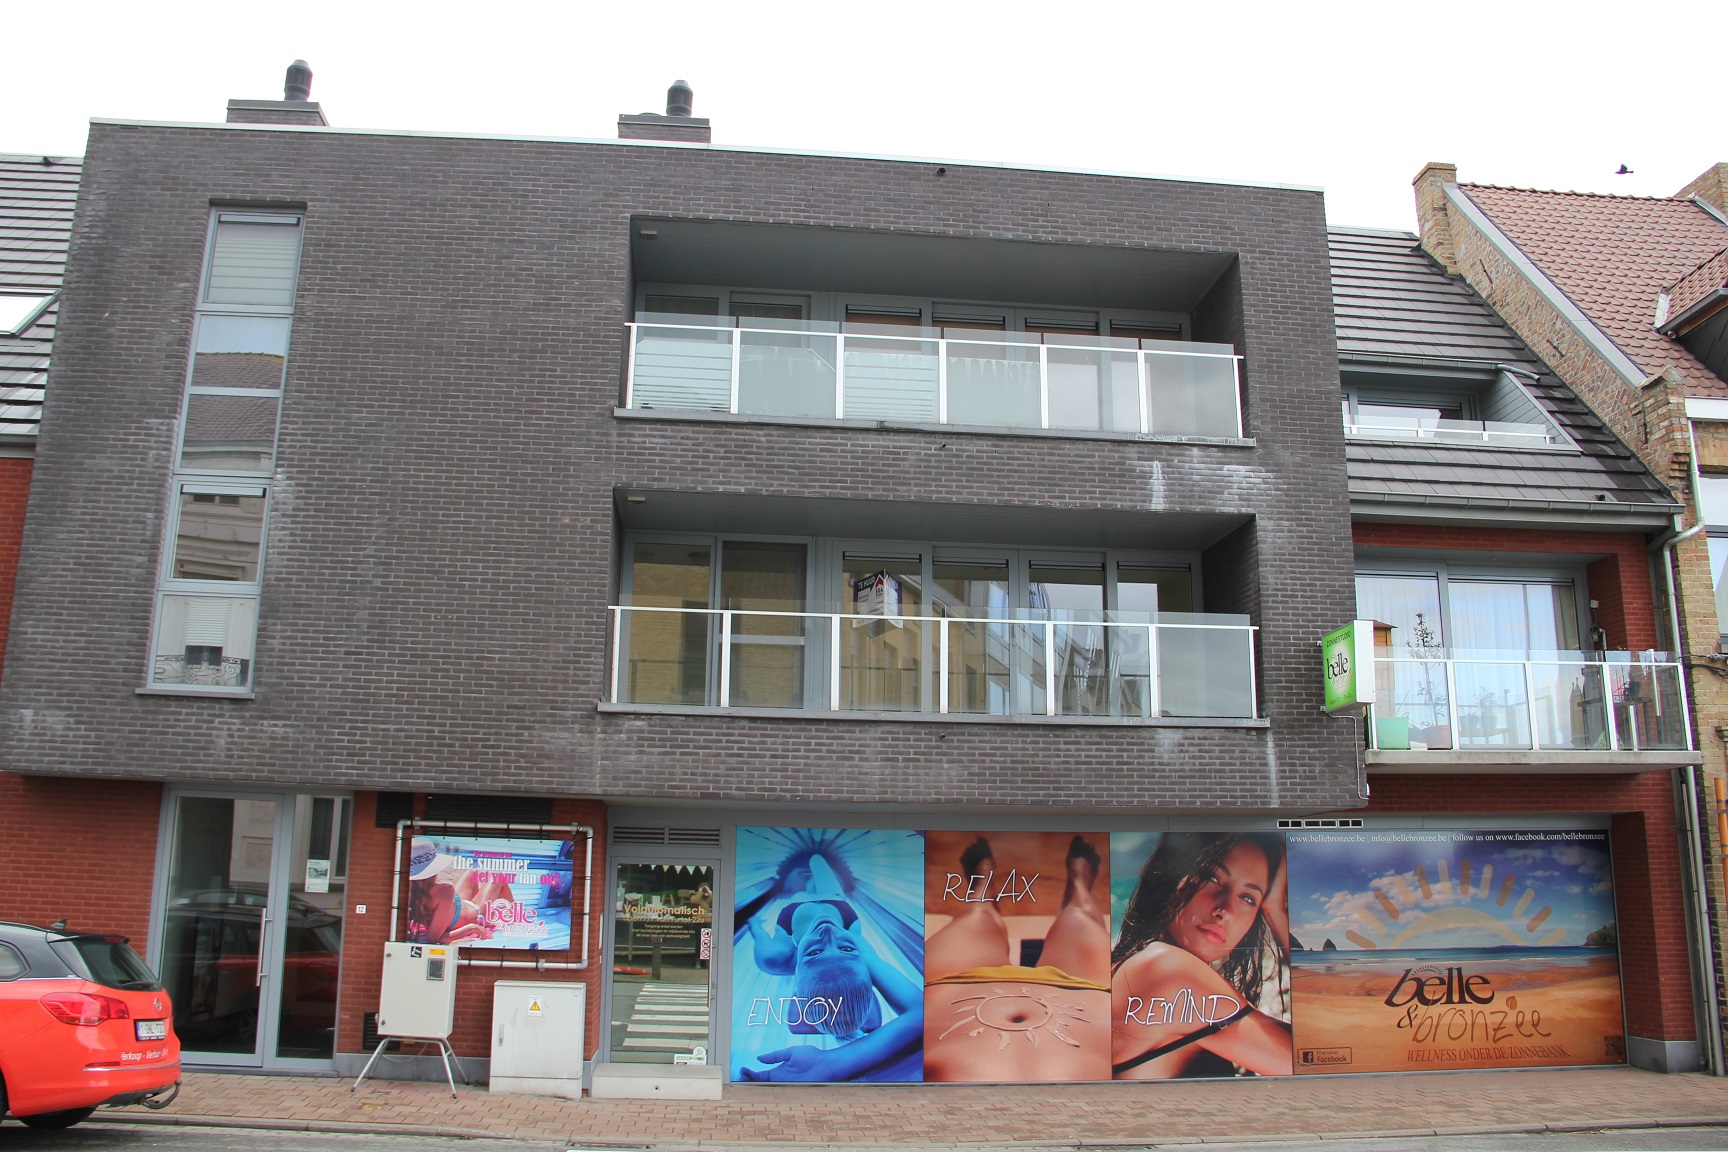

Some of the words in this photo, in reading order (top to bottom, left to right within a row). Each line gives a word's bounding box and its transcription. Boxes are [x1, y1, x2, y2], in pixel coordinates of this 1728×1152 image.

[858, 581, 864, 589] TE
[1326, 652, 1348, 680] belle
[1289, 834, 1366, 843] www.bellebronzee.be
[1371, 834, 1447, 842] info@bellebronzee.be
[1452, 832, 1474, 842] follow
[1496, 832, 1605, 841] www.facebook.com/bellebronzee
[453, 855, 474, 870] the
[478, 858, 530, 872] summer
[472, 871, 489, 884] get
[492, 873, 516, 884] your
[519, 874, 536, 884] tan
[943, 868, 1040, 904] RELAX
[485, 900, 538, 924] belle
[624, 904, 705, 915] Volautomatisch
[1384, 966, 1495, 1008] belle
[748, 996, 843, 1026] ENJOY
[1124, 988, 1240, 1026] REMIND
[1396, 1004, 1418, 1029] &
[1408, 1049, 1457, 1063] WELLNESS
[1458, 1047, 1491, 1061] ONDER
[1493, 1047, 1508, 1060] DE
[1510, 1044, 1570, 1060] ZONNEBANK
